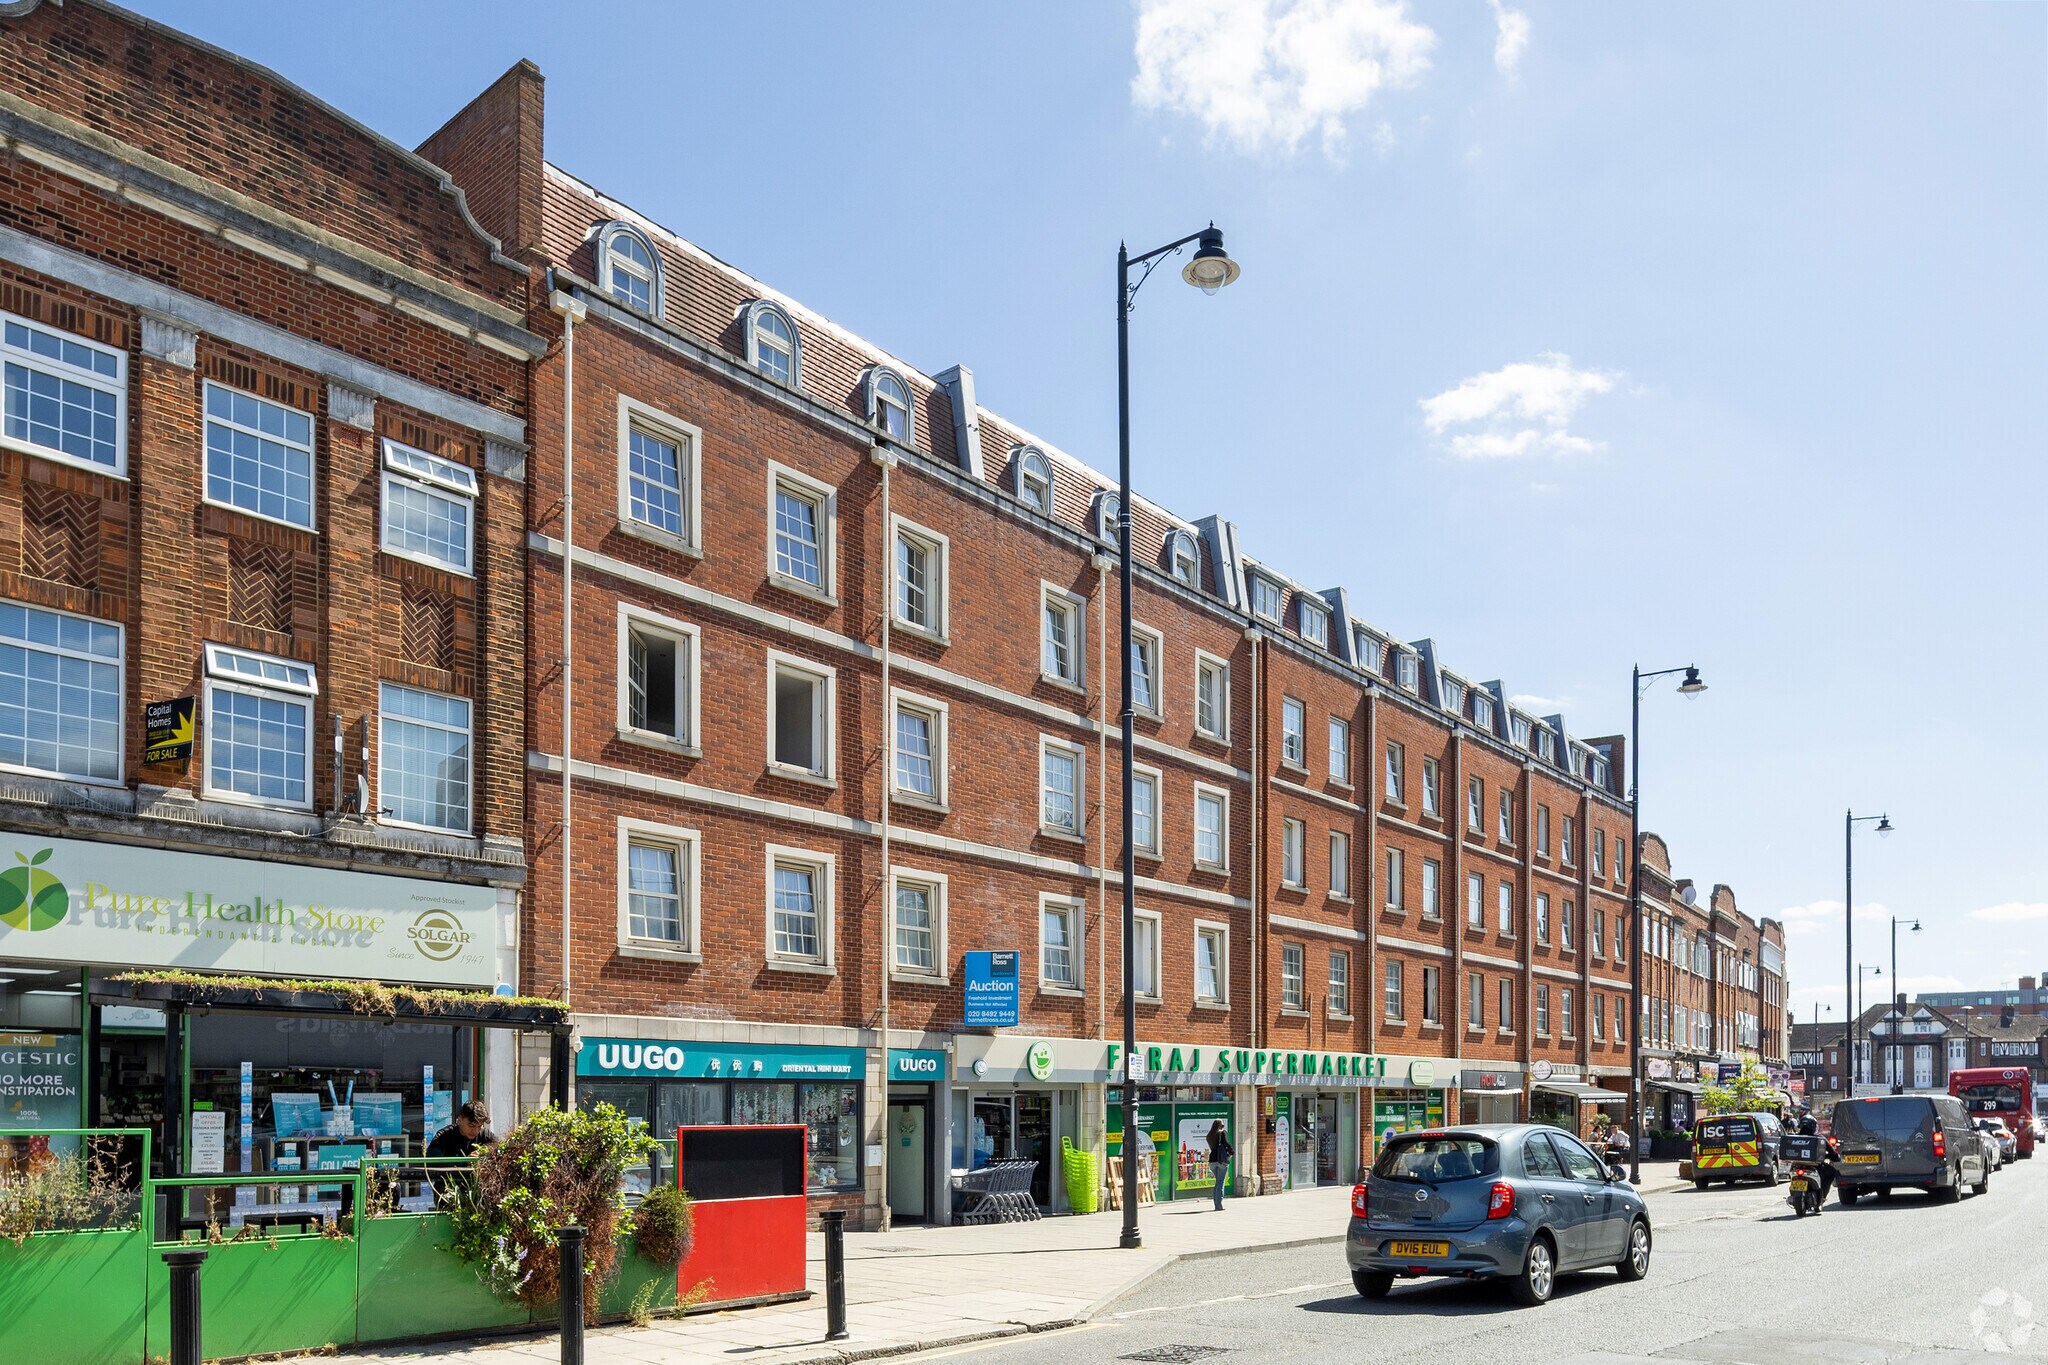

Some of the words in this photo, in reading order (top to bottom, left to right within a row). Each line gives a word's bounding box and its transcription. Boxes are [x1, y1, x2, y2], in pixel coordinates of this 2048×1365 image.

[148, 704, 171, 717] Capital
[148, 718, 171, 728] Homes
[146, 750, 160, 761] FOR
[161, 748, 178, 759] SALE
[411, 894, 441, 903] Approved
[441, 896, 465, 905] Stockist
[86, 880, 171, 916] Pure
[185, 891, 295, 926] Health
[306, 903, 385, 933] Store
[137, 924, 258, 941] INDEPENDANT
[291, 936, 337, 948] LOCAL
[407, 927, 470, 944] SOLGAR
[386, 947, 415, 960] Since
[459, 953, 484, 965] 1947
[992, 952, 1014, 960] Barnett
[969, 980, 1014, 991] Auction
[13, 1036, 41, 1044] NEW
[598, 1044, 684, 1071] UUGO
[1107, 1044, 1200, 1072] FRAJ
[1219, 1049, 1388, 1077] SUPERMARKET
[782, 1064, 817, 1072] ORIENTAL
[817, 1064, 832, 1072] MINI
[832, 1065, 852, 1073] MART
[900, 1058, 937, 1072] UUGO
[20, 1074, 62, 1085] MORE
[1232, 1074, 1271, 1084] GROCERIES
[1288, 1075, 1309, 1084] FRESH
[1984, 1101, 1997, 1110] 299
[1396, 1243, 1419, 1254] DV16
[1421, 1243, 1442, 1254] EUL
